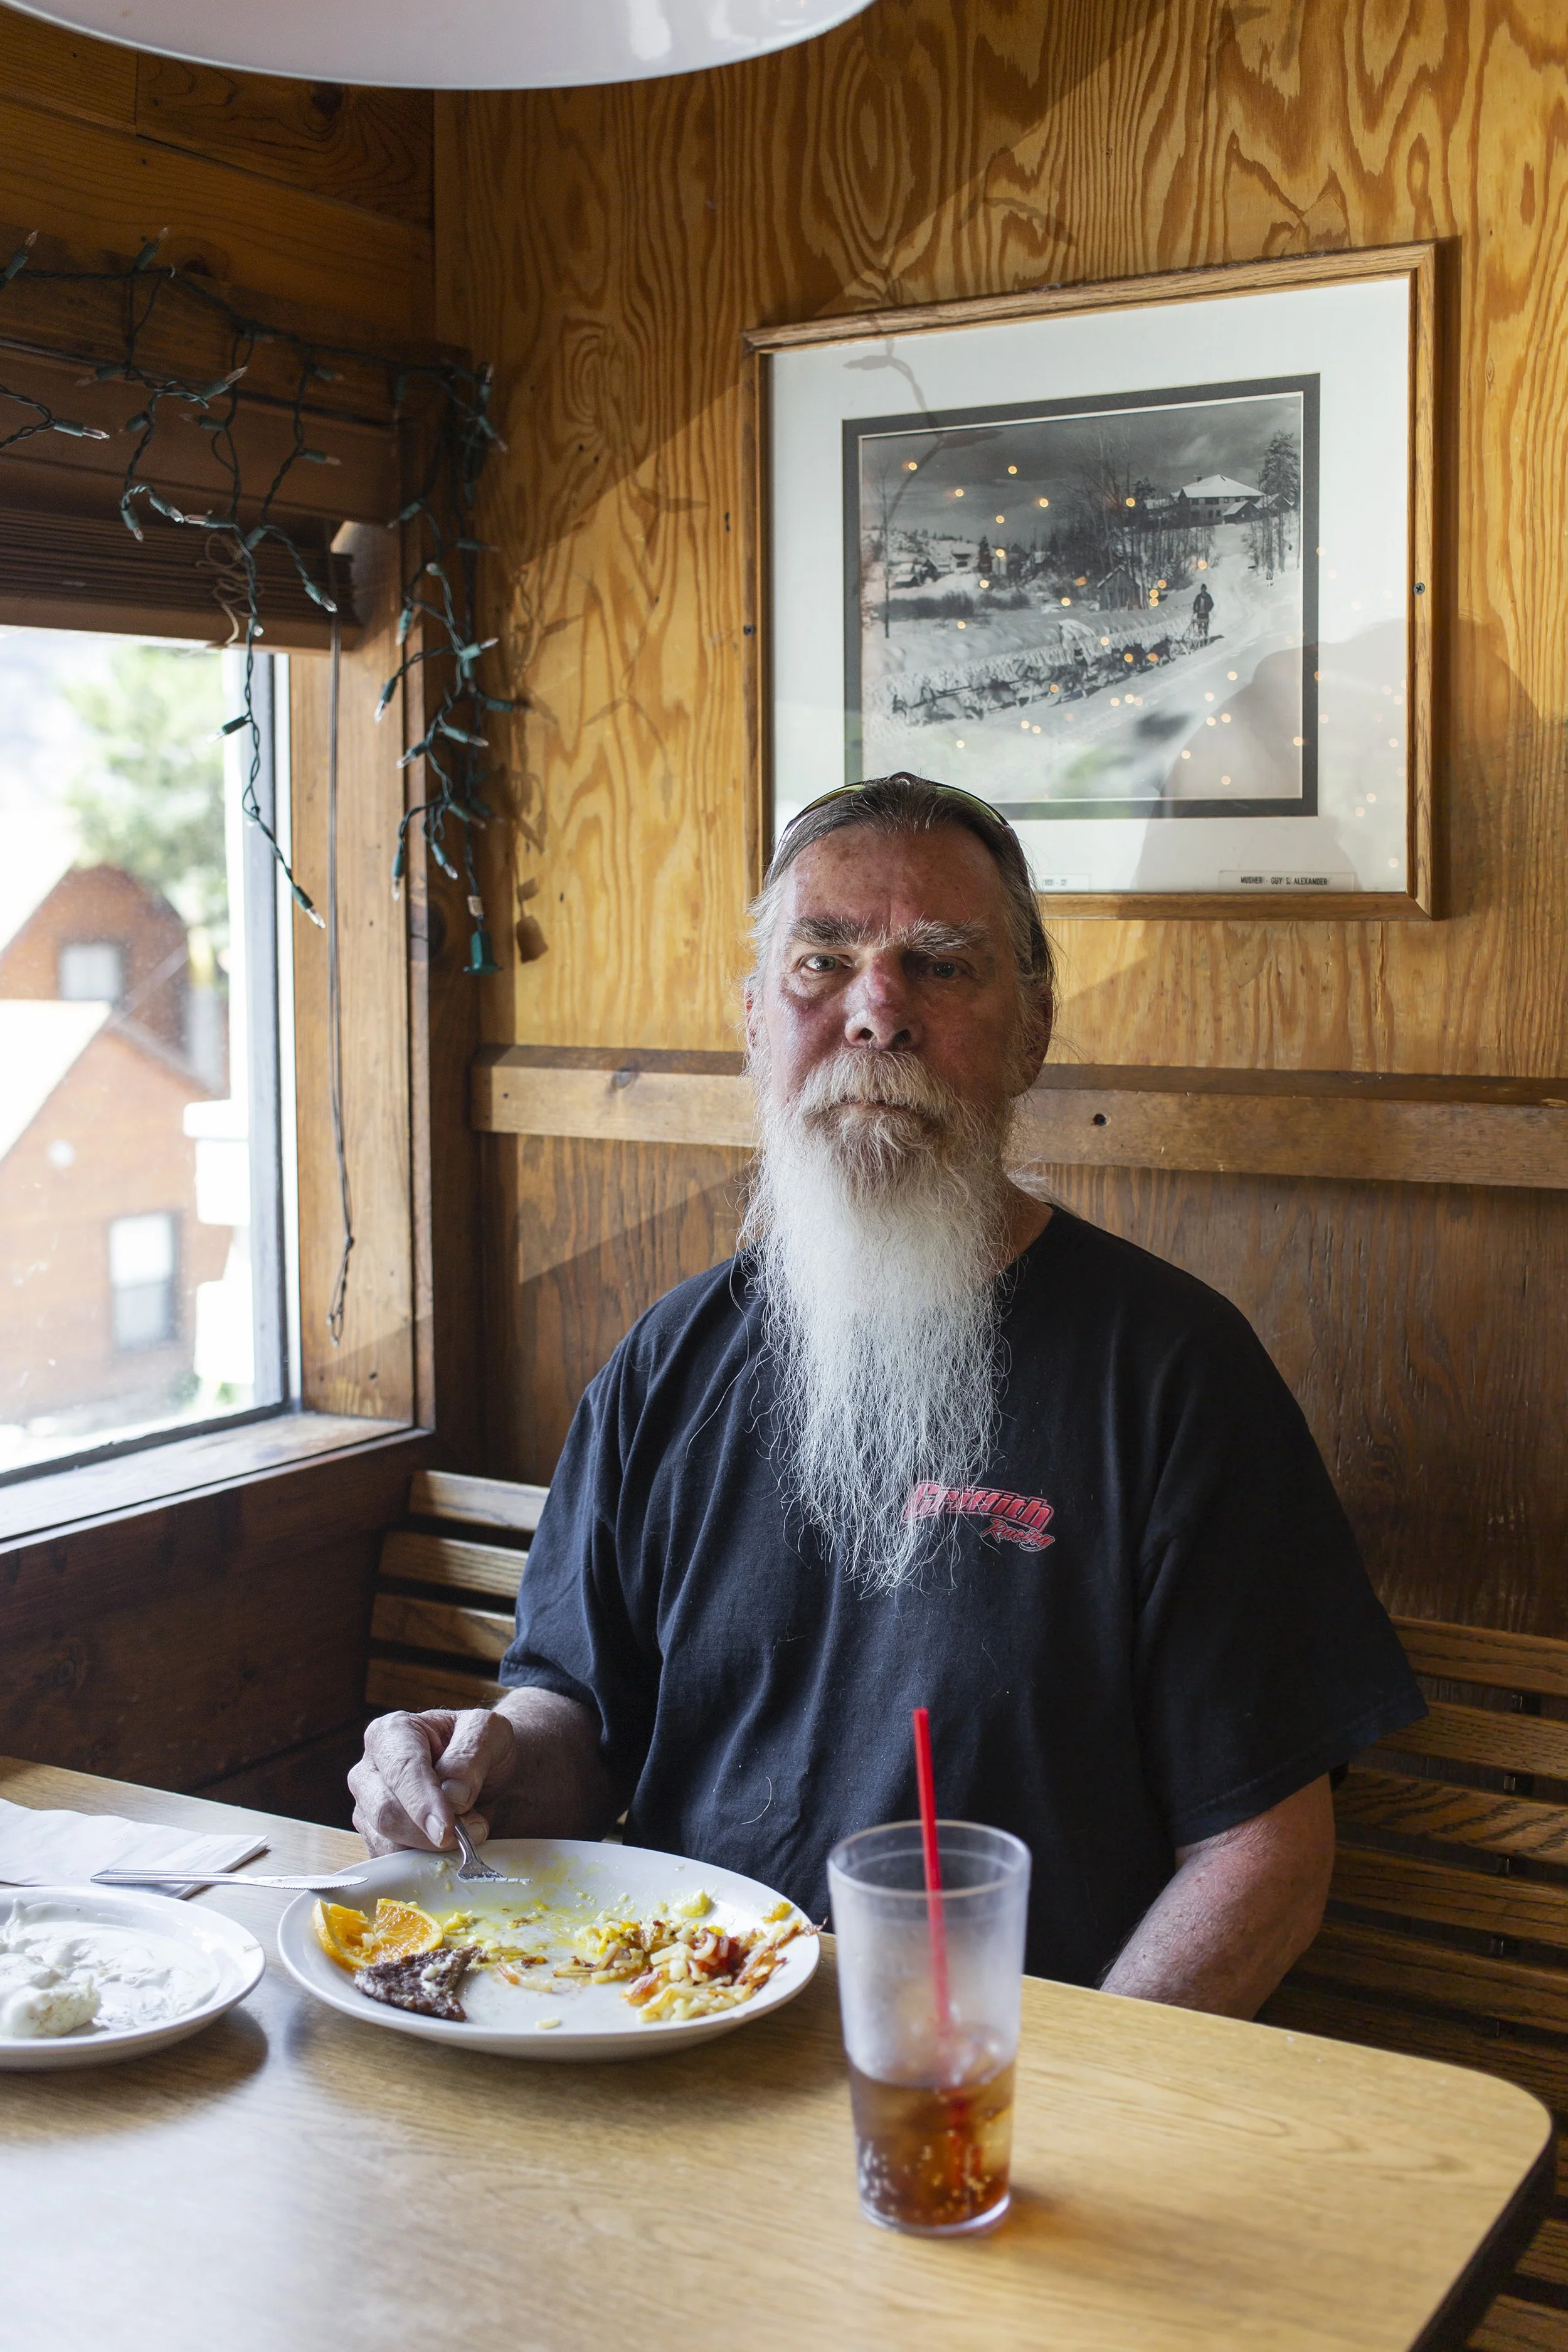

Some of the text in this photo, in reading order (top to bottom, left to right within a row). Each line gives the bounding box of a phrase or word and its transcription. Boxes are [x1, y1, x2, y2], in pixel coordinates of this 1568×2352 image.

[1241, 876, 1263, 884] MUSHER
[1293, 877, 1328, 886] ALEXANDER
[981, 1518, 1056, 1552] Racing
